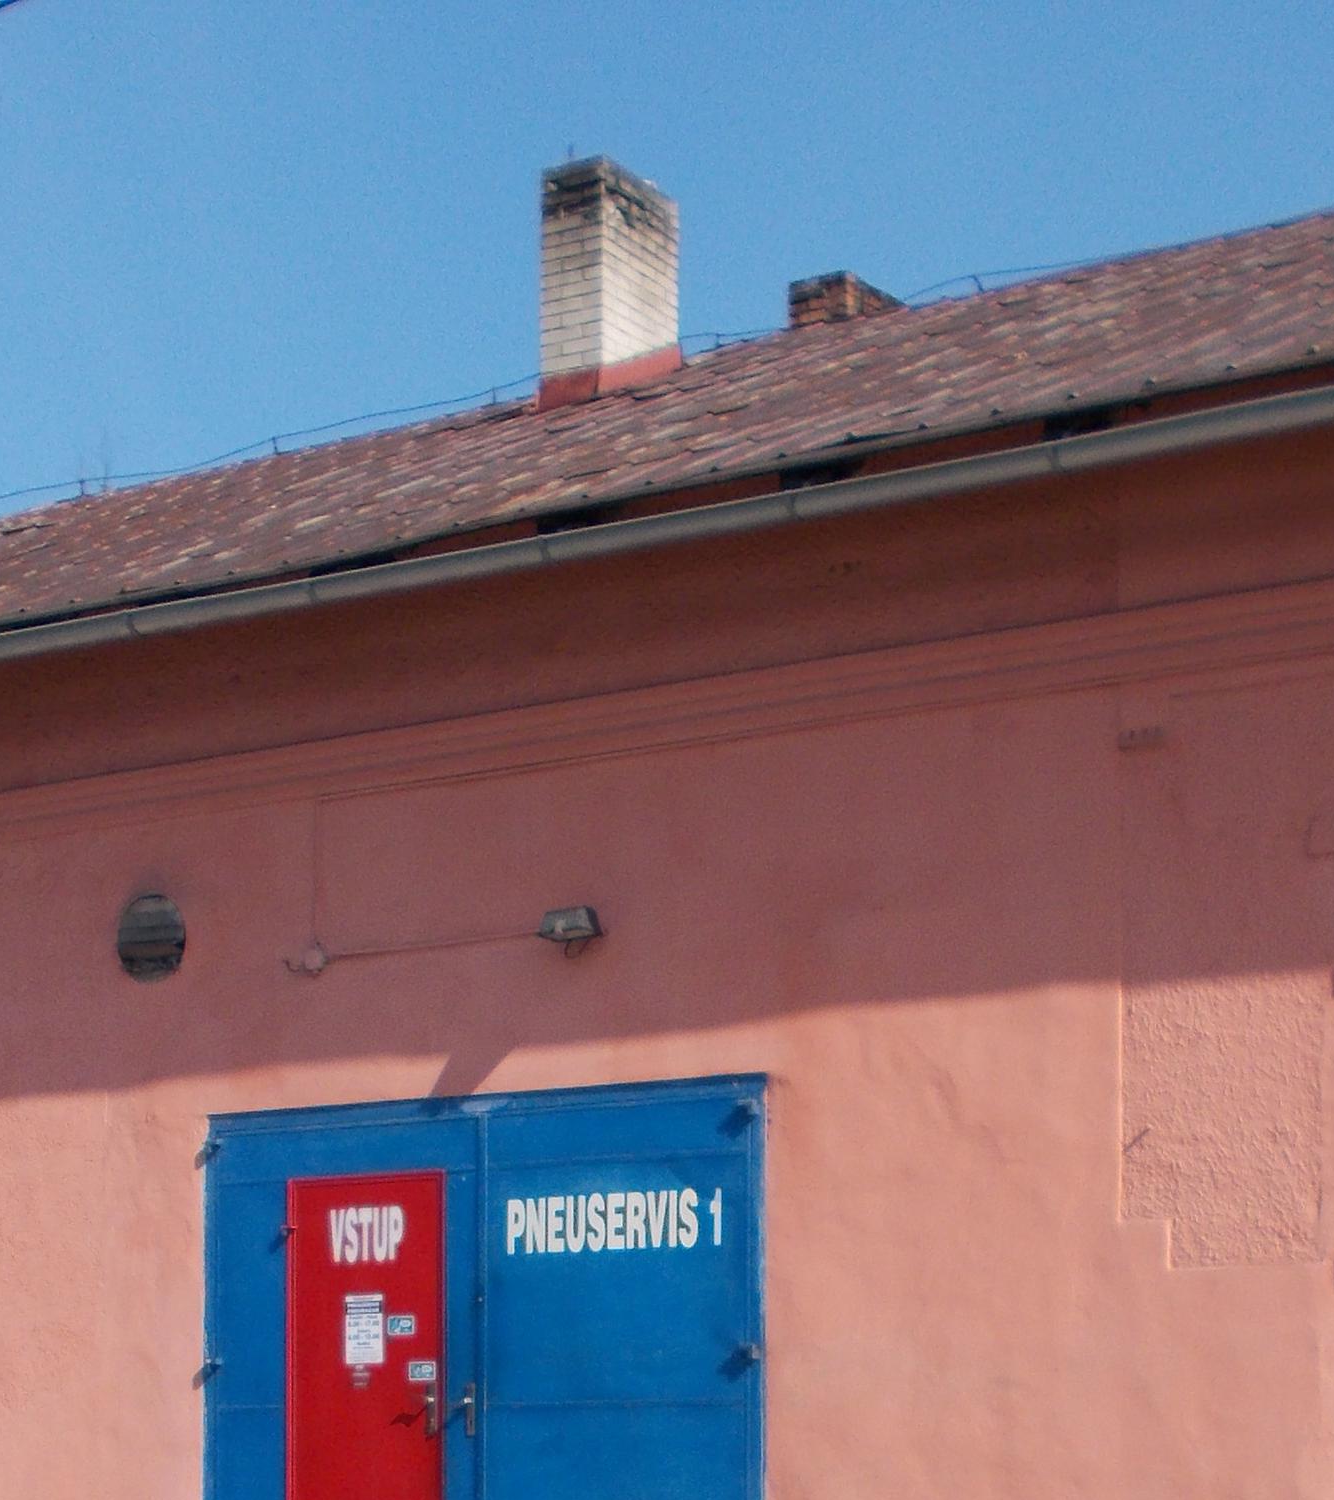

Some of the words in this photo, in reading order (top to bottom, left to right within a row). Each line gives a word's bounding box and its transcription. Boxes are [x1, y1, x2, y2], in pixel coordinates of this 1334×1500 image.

[330, 1205, 404, 1264] VSTUP
[506, 1187, 699, 1255] PNEUSERVIS
[709, 1187, 722, 1246] 1
